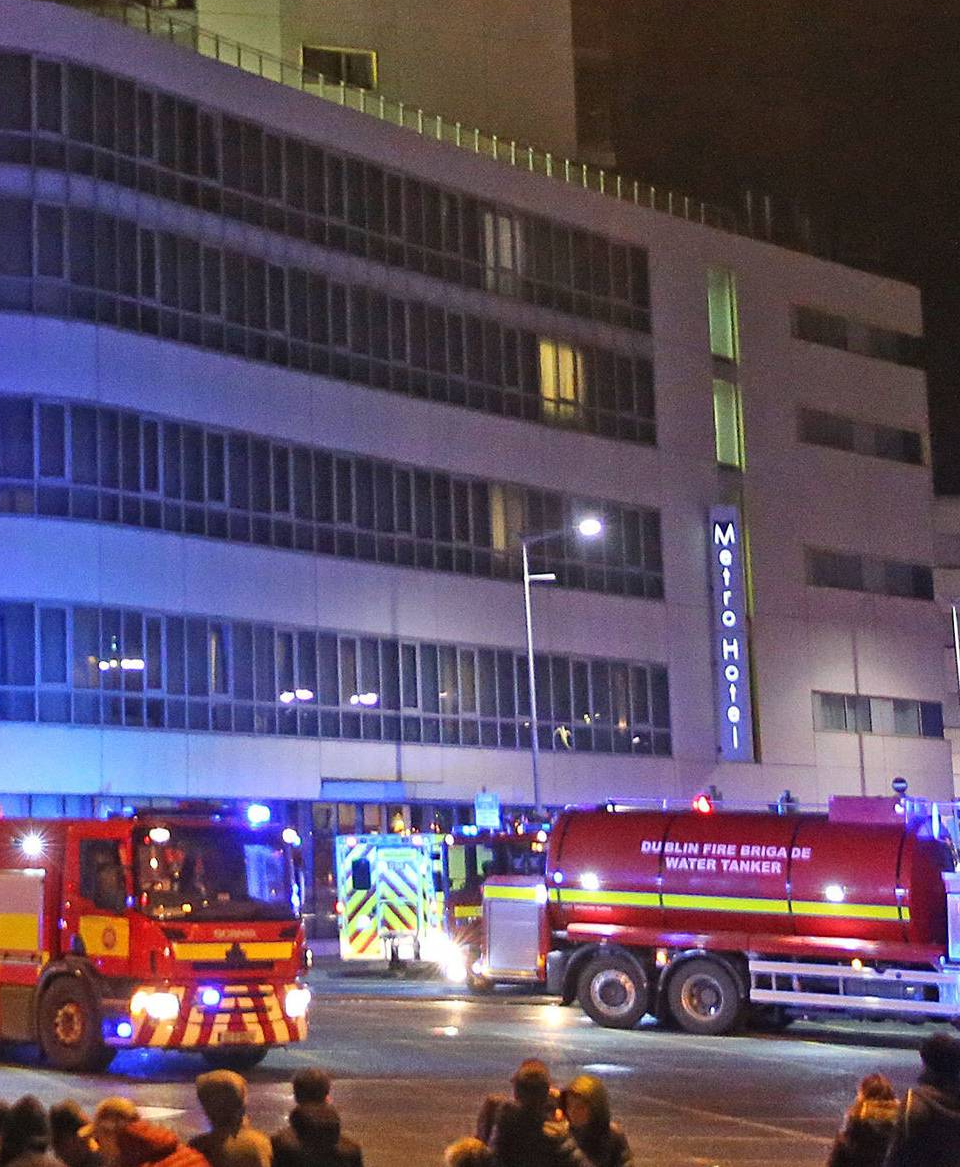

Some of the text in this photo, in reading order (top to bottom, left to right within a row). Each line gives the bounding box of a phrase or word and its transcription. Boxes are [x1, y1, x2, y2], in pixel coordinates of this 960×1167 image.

[713, 522, 741, 750] Metro Hotel
[640, 840, 812, 859] DUBLIN FIRE BRIGADE
[664, 857, 782, 874] WATER TANKER
